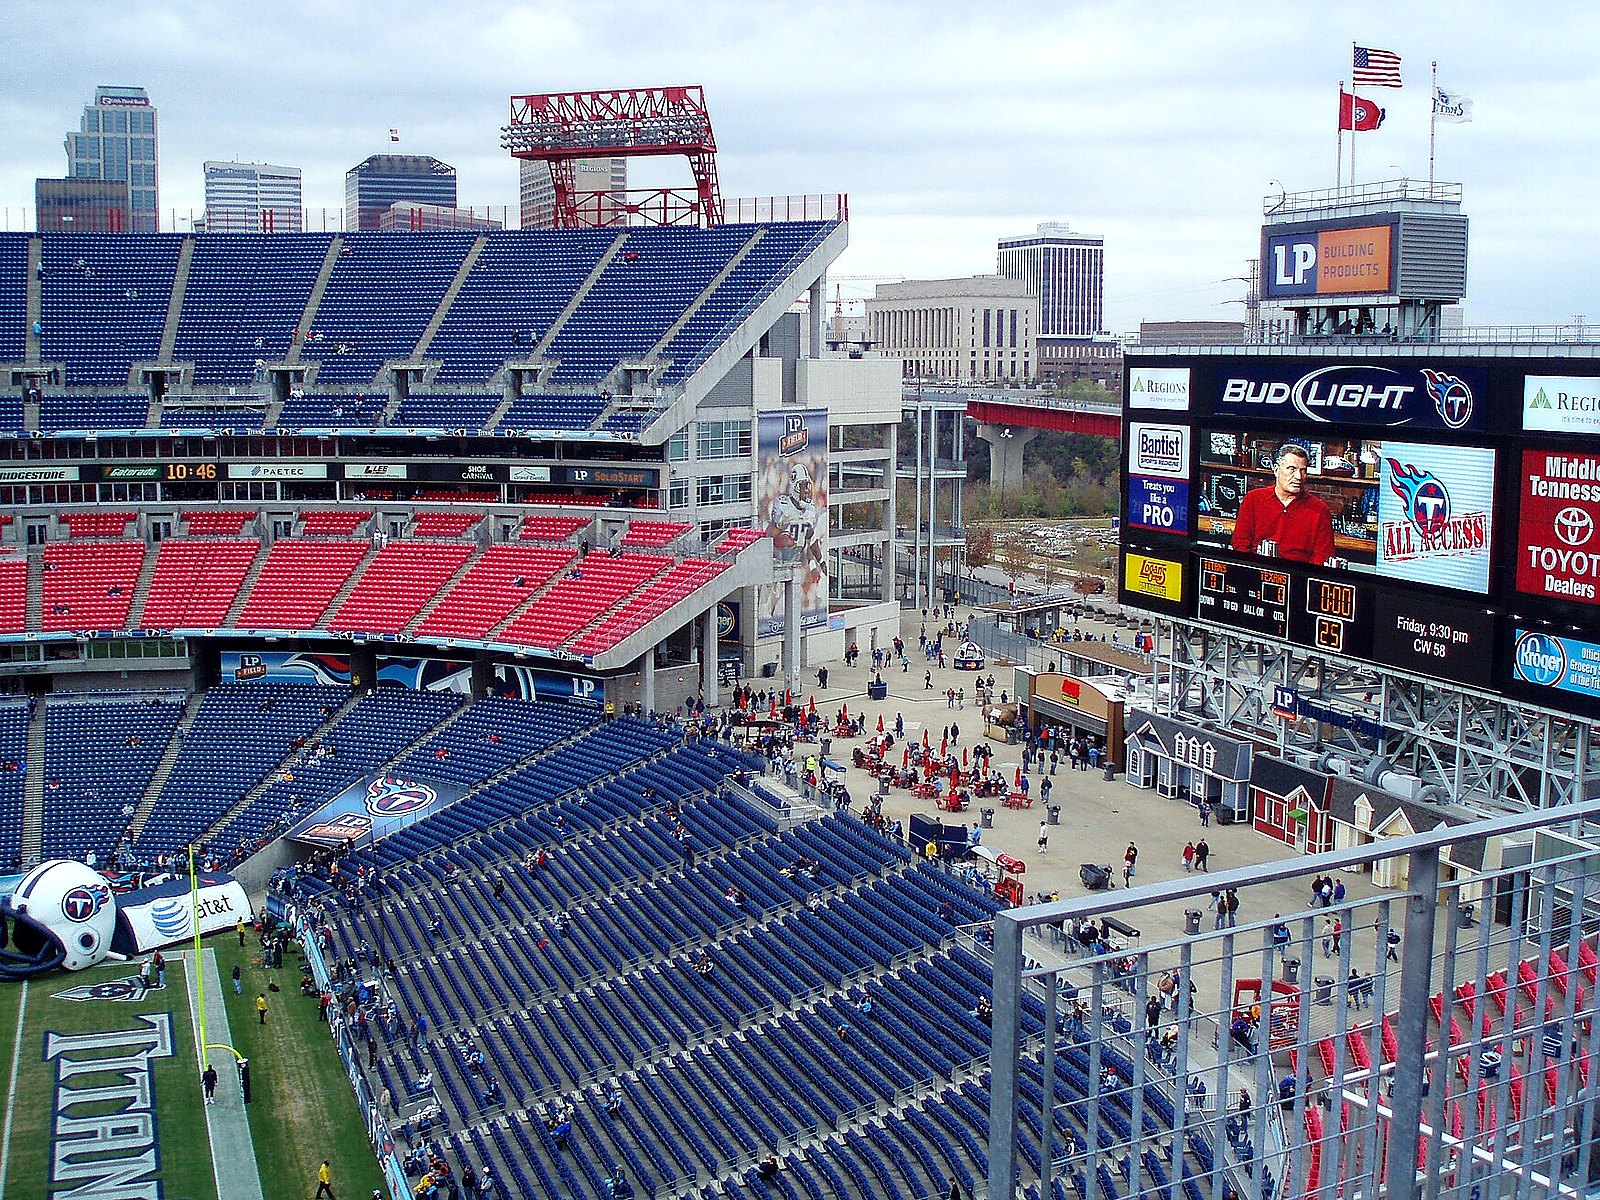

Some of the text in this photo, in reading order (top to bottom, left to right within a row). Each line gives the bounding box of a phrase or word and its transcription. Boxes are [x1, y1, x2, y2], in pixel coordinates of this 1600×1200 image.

[581, 165, 609, 173] REGIONS
[1323, 242, 1375, 259] BUILDING
[1273, 242, 1317, 285] LP
[1323, 263, 1379, 279] PRODUCTS
[1147, 379, 1187, 394] REGIONS
[1222, 378, 1414, 409] BUD LIGHT
[1557, 392, 1600, 412] REGI
[788, 418, 801, 432] LP
[1141, 433, 1180, 458] Baptist
[110, 467, 157, 477] Gatorade
[166, 464, 217, 480] 10:46
[263, 468, 304, 476] PAETEC
[468, 465, 487, 473] SHOE
[574, 470, 588, 481] LP
[1142, 479, 1175, 494] Treats you
[1149, 492, 1167, 505] like a
[1142, 503, 1174, 527] PRO
[1385, 515, 1484, 557] ALL ACCESS
[1203, 560, 1227, 573] TITANS
[1527, 545, 1600, 577] TOYOT
[1260, 570, 1287, 585] TEXANS
[1544, 574, 1596, 599] Dealers
[1199, 594, 1215, 606] DOWN
[1223, 599, 1239, 612] TO GO
[1320, 583, 1351, 617] 0:00
[1243, 603, 1265, 617] BALL ON
[1319, 621, 1339, 647] 25
[1396, 616, 1469, 644] Friday, 9:30 pm
[1413, 638, 1446, 658] CW 58
[244, 656, 260, 666] LP
[1520, 637, 1563, 682] Kroger
[1570, 659, 1598, 677] Grocery
[572, 677, 595, 698] LP
[1578, 674, 1590, 687] the
[1276, 689, 1293, 708] LP
[338, 815, 367, 827] LP
[197, 894, 234, 919] at&t
